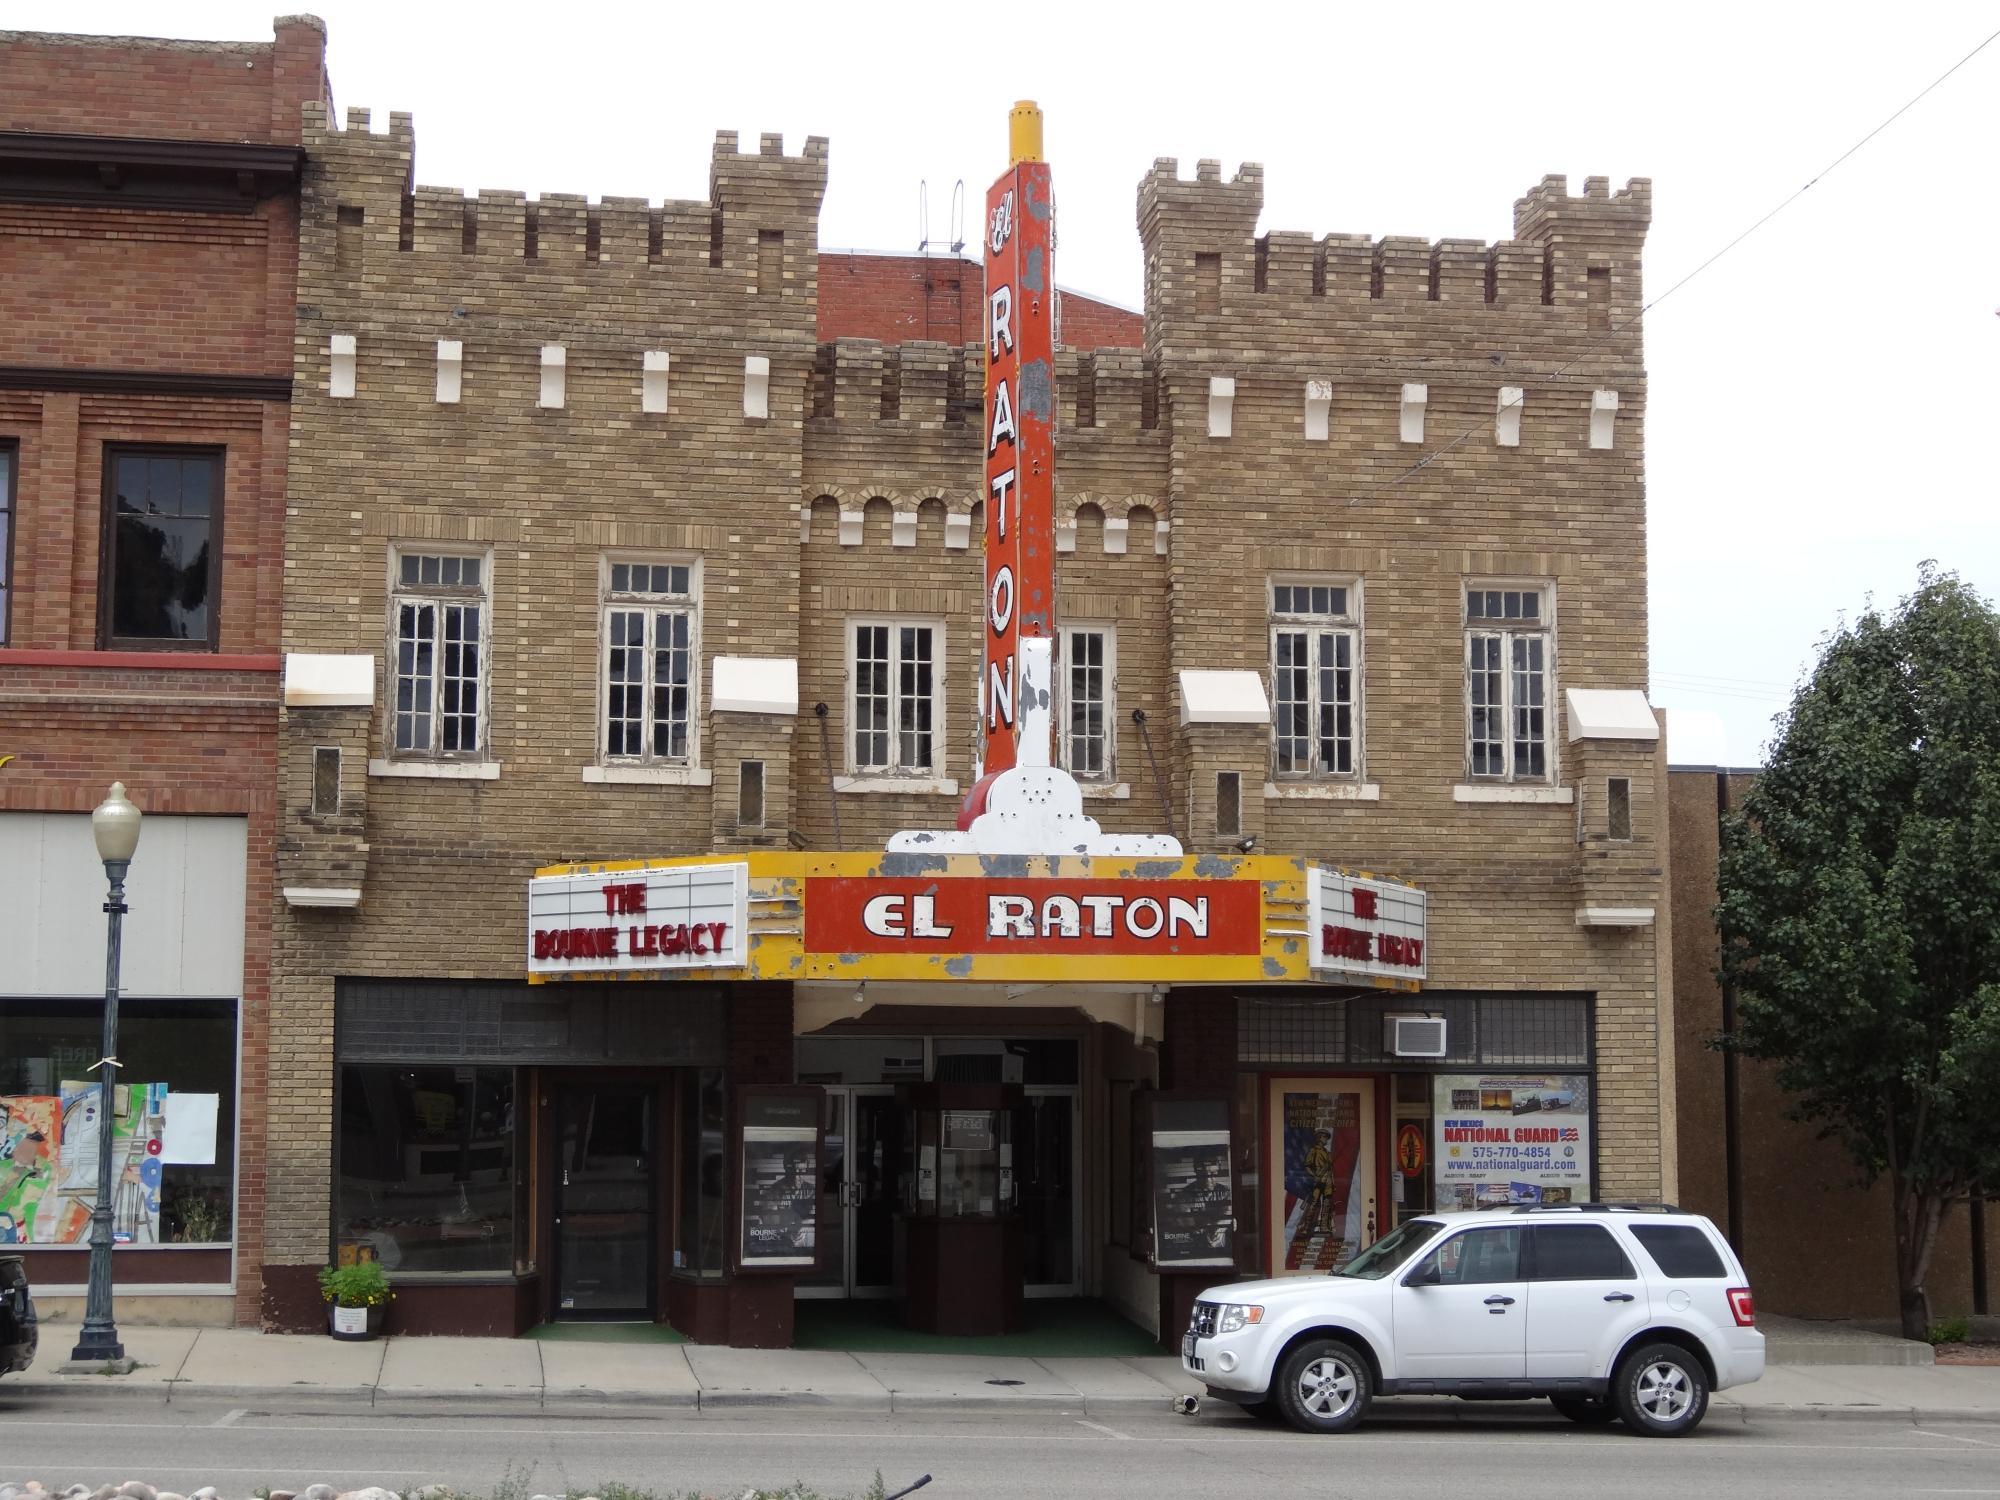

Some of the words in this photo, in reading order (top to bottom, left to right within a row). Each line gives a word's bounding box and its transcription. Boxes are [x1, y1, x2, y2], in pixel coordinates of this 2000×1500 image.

[987, 284, 1016, 733] RATON
[603, 883, 646, 916] THE
[863, 895, 952, 937] EL
[988, 895, 1207, 938] RATON
[534, 927, 619, 960] BOURNE
[629, 922, 726, 956] LEGACY
[1444, 1128, 1511, 1143] NATIONAL
[1514, 1128, 1559, 1143] GUARD
[1448, 1159, 1576, 1171] www.nationalguard.com
[1472, 1147, 1551, 1158] 575-770-4854
